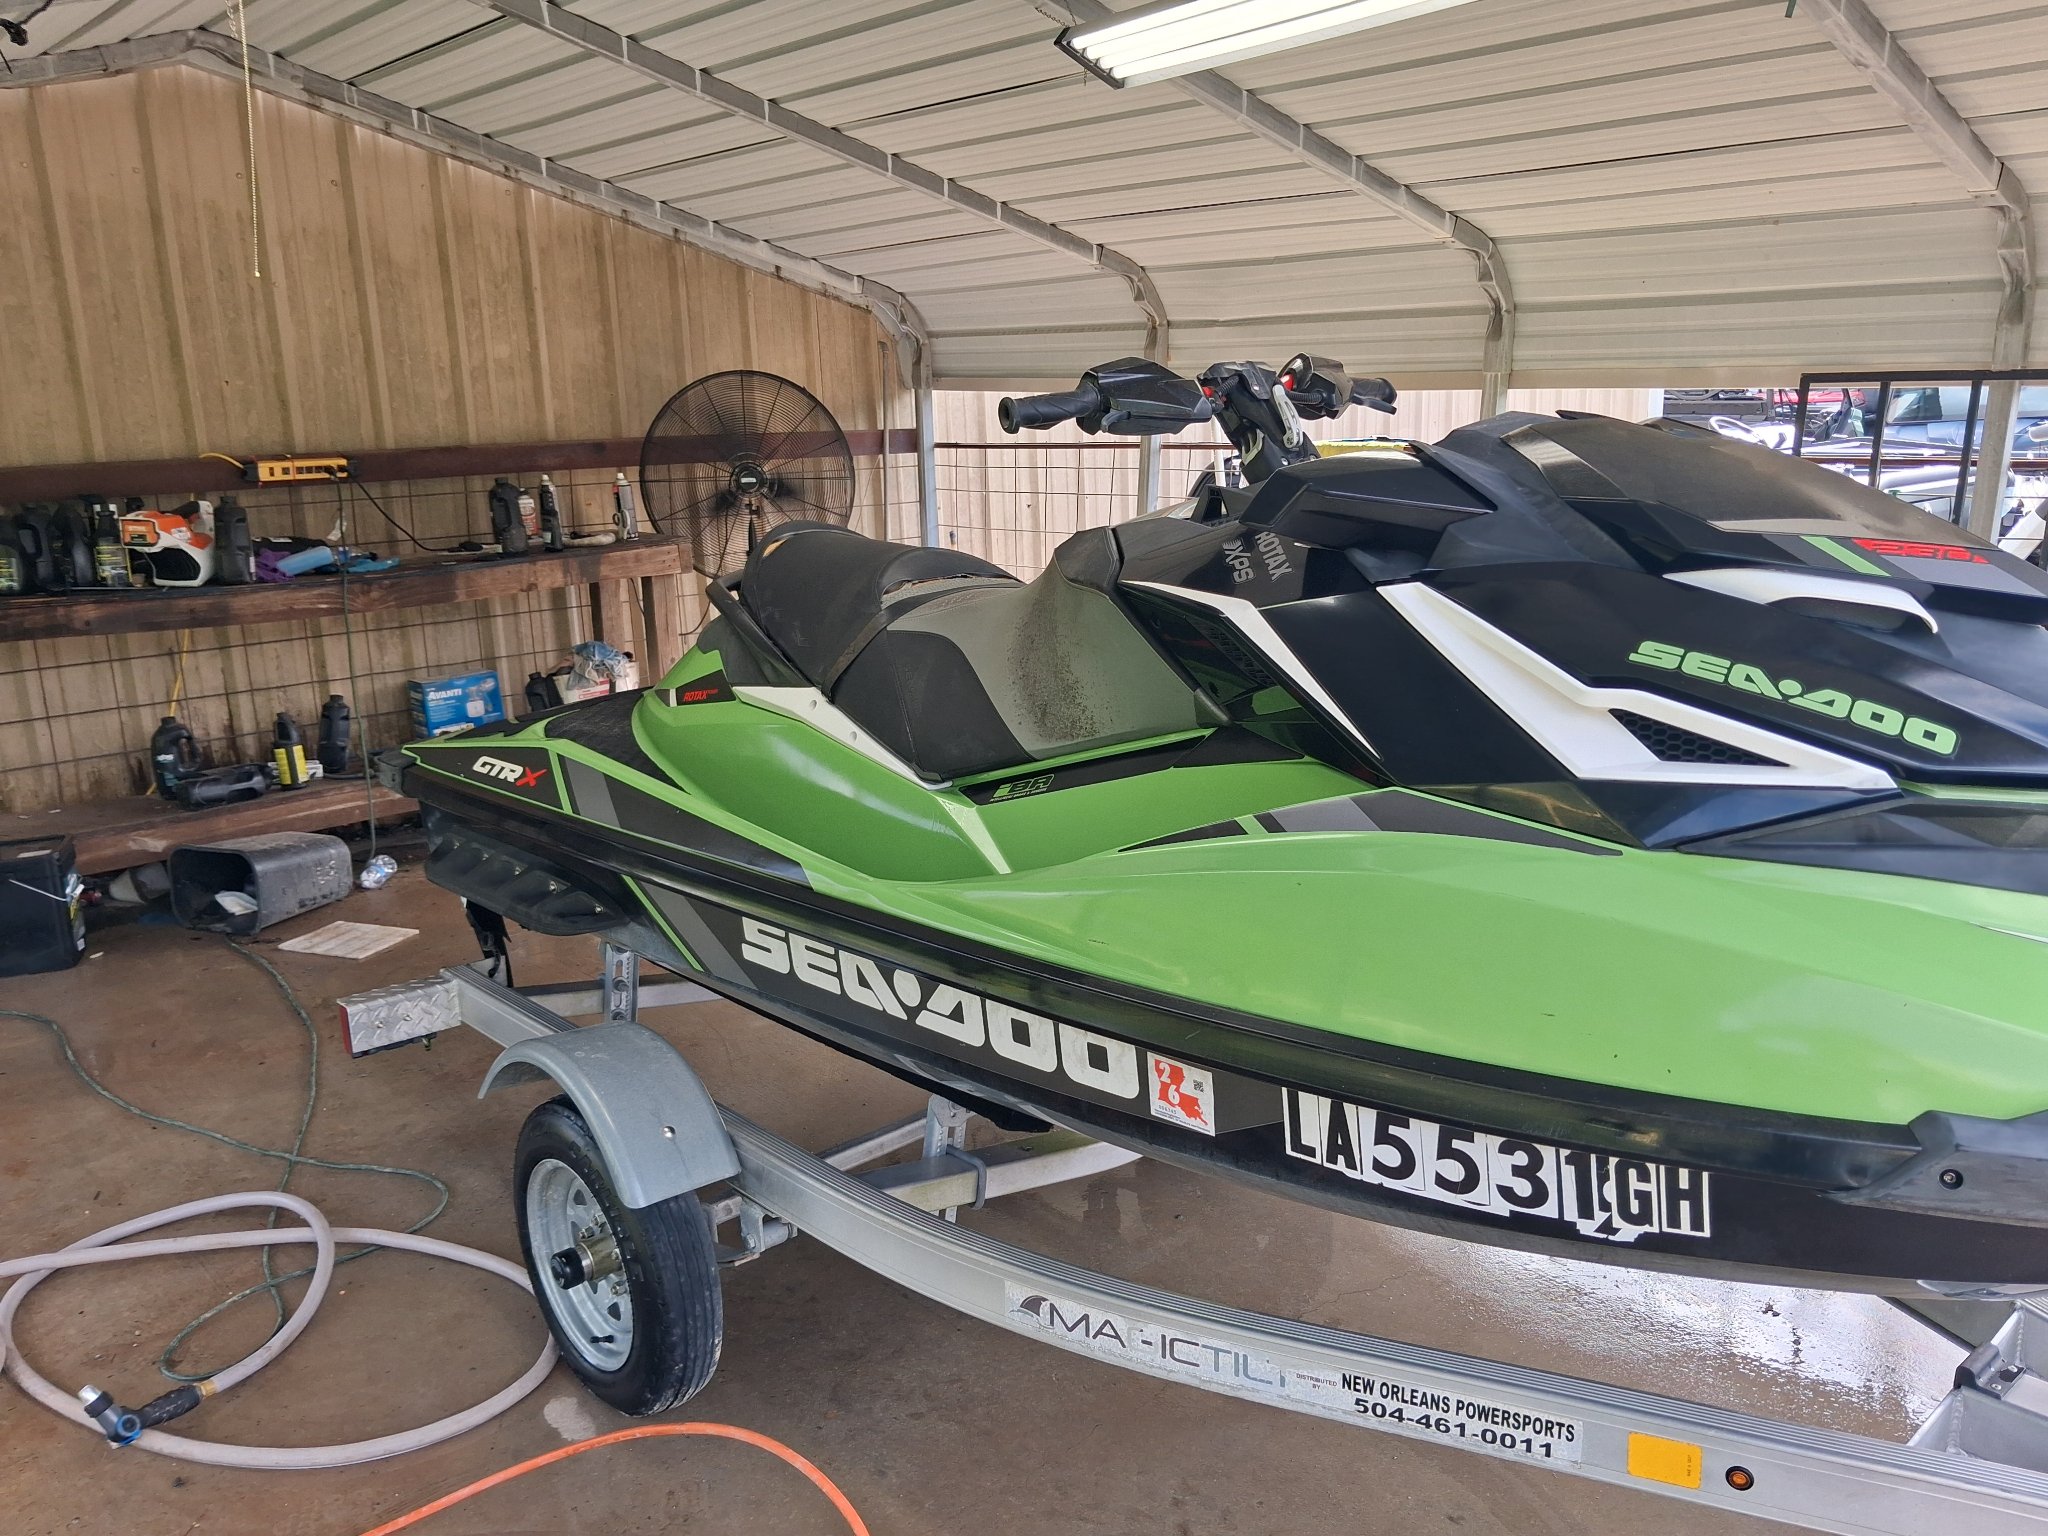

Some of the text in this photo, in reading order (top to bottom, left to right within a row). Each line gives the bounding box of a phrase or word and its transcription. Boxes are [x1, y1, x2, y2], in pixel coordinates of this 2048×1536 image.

[1224, 544, 1255, 584] XPS
[1254, 531, 1293, 582] ROTAX
[1048, 1302, 1287, 1388] MAICTIL
[1295, 1373, 1338, 1388] DISTRIBUTED
[1341, 1373, 1576, 1443] NEW ORLEANS POWERSPORTS
[1353, 1397, 1552, 1458] 504-461-0011
